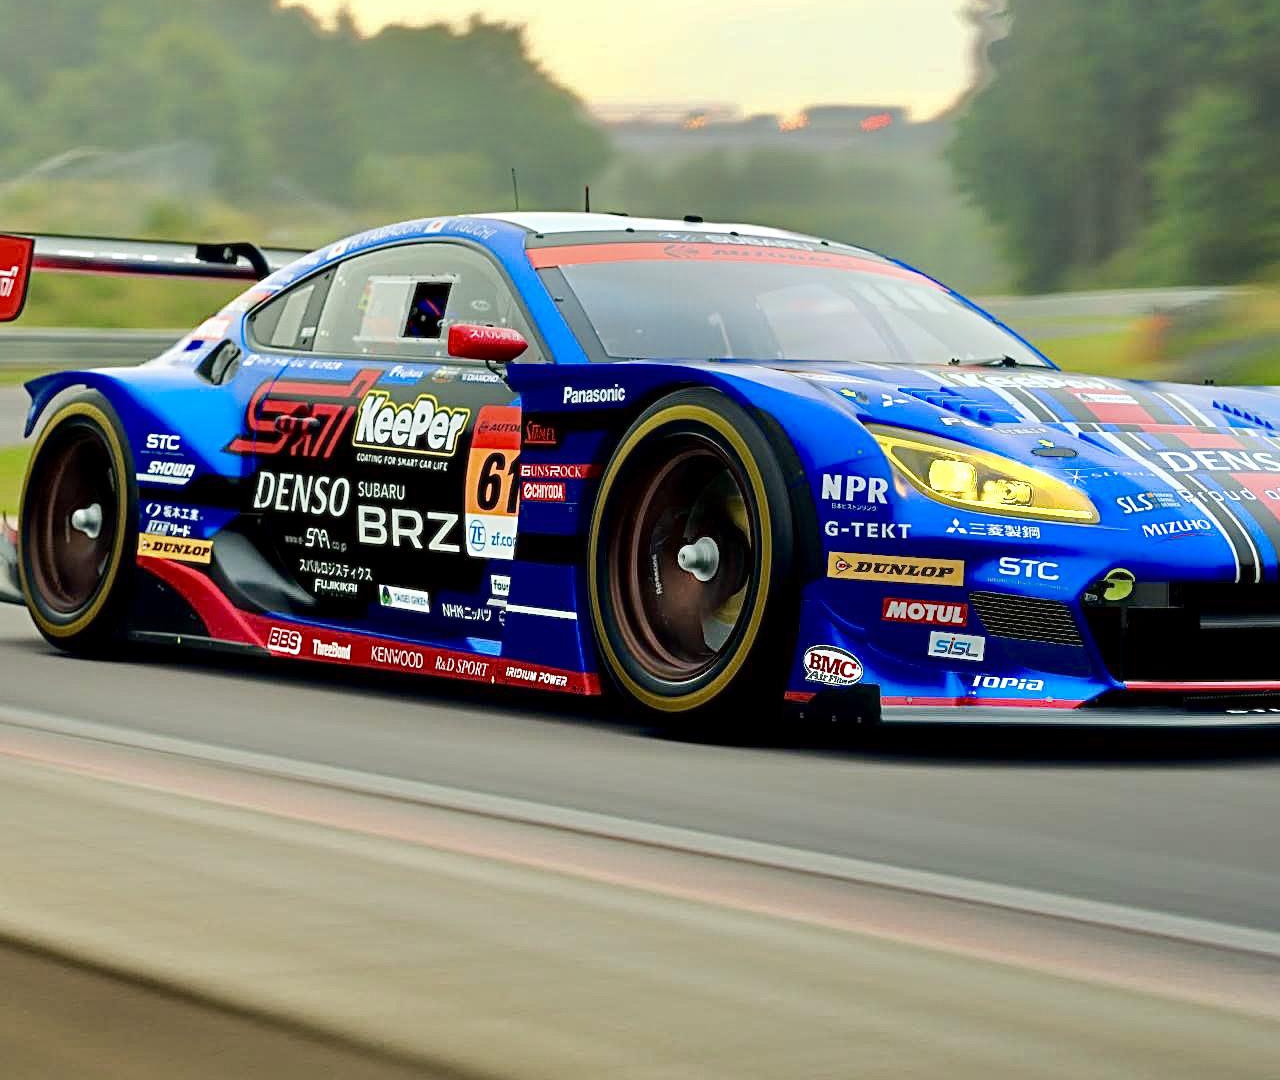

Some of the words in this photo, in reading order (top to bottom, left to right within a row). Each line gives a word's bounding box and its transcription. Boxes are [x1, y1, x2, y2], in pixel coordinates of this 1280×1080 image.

[563, 384, 626, 404] Panasonic
[354, 391, 470, 451] KeePer
[146, 433, 181, 451] STC
[147, 460, 196, 477] SHOWA
[384, 456, 397, 466] FOR
[397, 457, 418, 469] SMART
[419, 460, 433, 470] CAR
[434, 461, 448, 471] LIFE
[358, 481, 406, 501] SUBARU
[477, 451, 521, 514] 61
[532, 483, 563, 499] CHIYODA
[821, 473, 889, 504] NPR
[253, 470, 351, 517] DENSO
[1116, 493, 1154, 514] SLS
[1175, 487, 1257, 504] Proud
[358, 505, 461, 553] BRZ
[824, 520, 913, 539] G-TEKT
[1141, 518, 1211, 539] MIZUHO
[152, 541, 210, 557] DUNLOP
[299, 558, 373, 581] スバルロジスティクス
[853, 561, 955, 578] DUNLOP
[998, 556, 1060, 581] STC
[885, 600, 964, 623] MOTUL
[269, 627, 302, 654] BBS
[312, 639, 351, 661] ThreeBond
[371, 646, 423, 668] KENWOOD
[435, 655, 455, 672] R&D
[457, 659, 489, 678] SPORT
[809, 652, 857, 679] BMC
[506, 666, 537, 681] IRIDIUM
[538, 672, 568, 686] POWER
